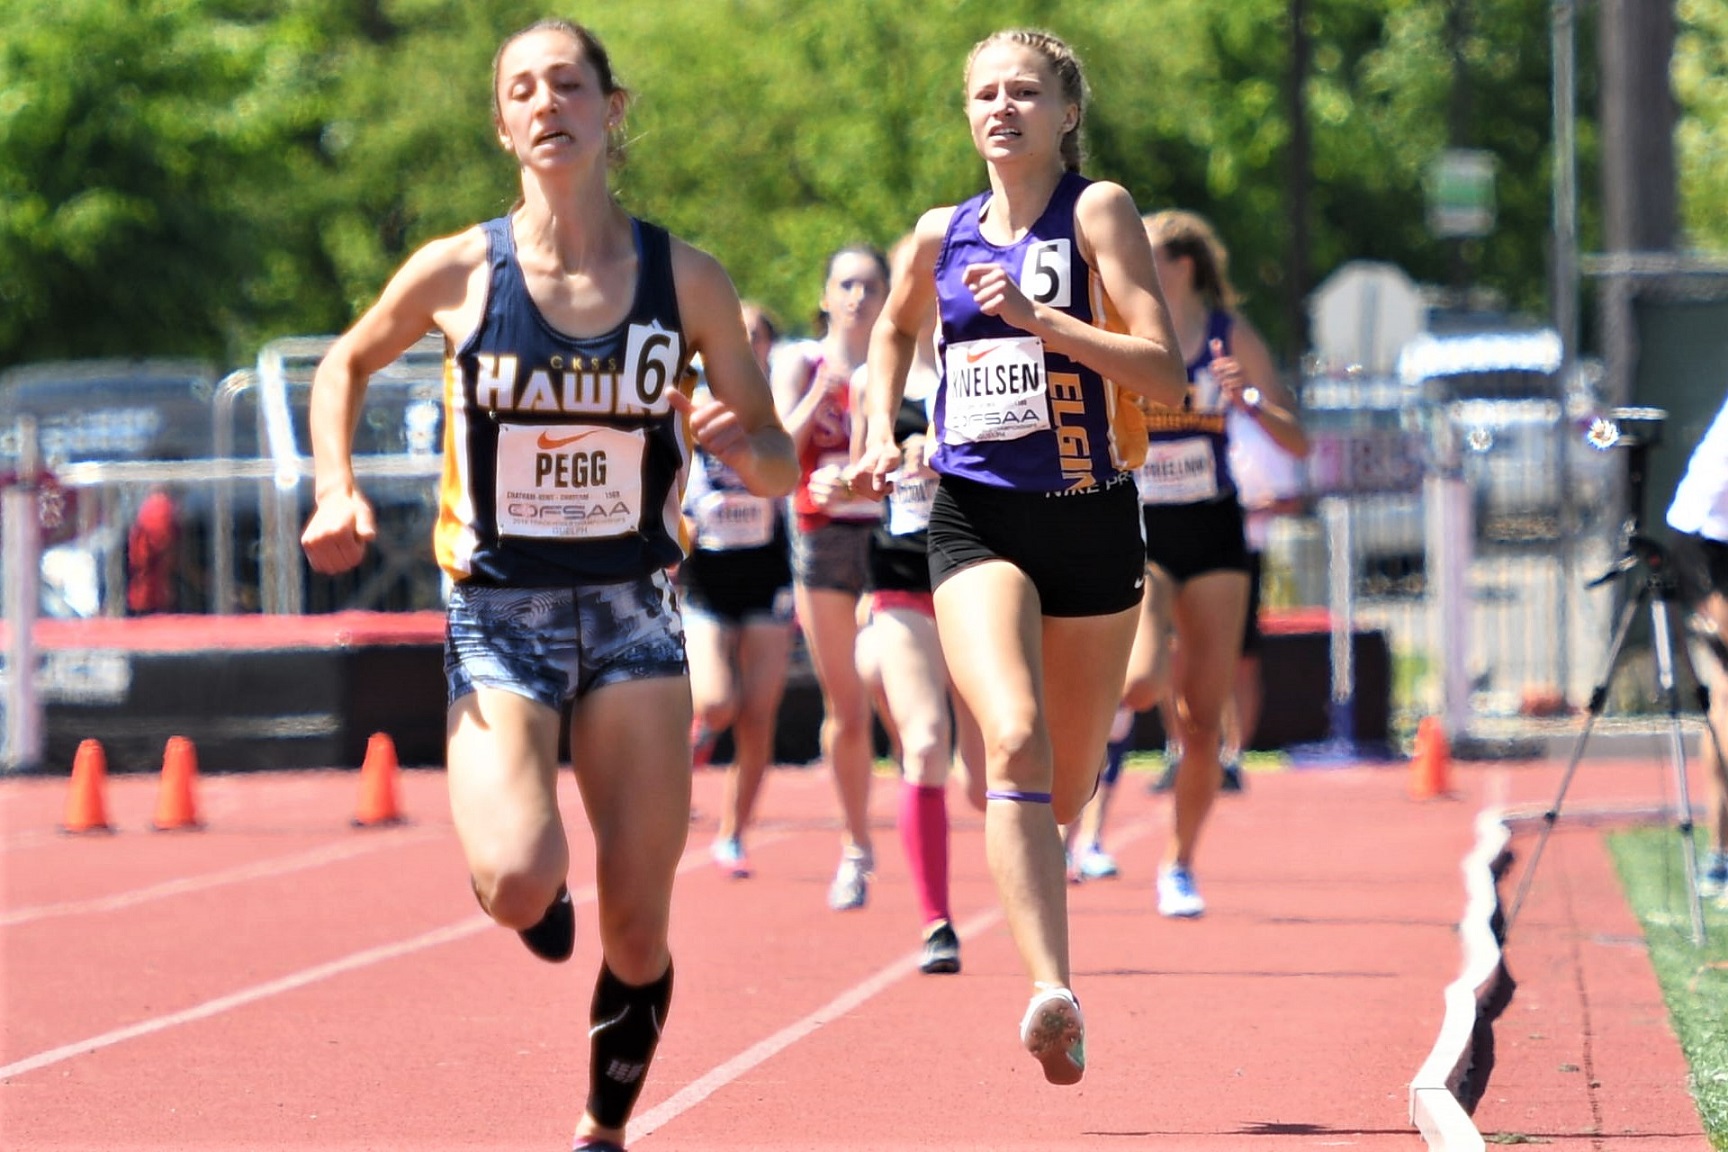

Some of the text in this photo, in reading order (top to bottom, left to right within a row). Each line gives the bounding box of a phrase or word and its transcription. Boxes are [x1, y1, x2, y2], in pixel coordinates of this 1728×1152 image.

[1033, 244, 1059, 303] 5
[550, 355, 617, 370] CKSS
[635, 334, 671, 405] 6
[952, 362, 1039, 398] KNELSEN
[535, 450, 607, 489] PEGG
[508, 501, 631, 520] OFSAA
